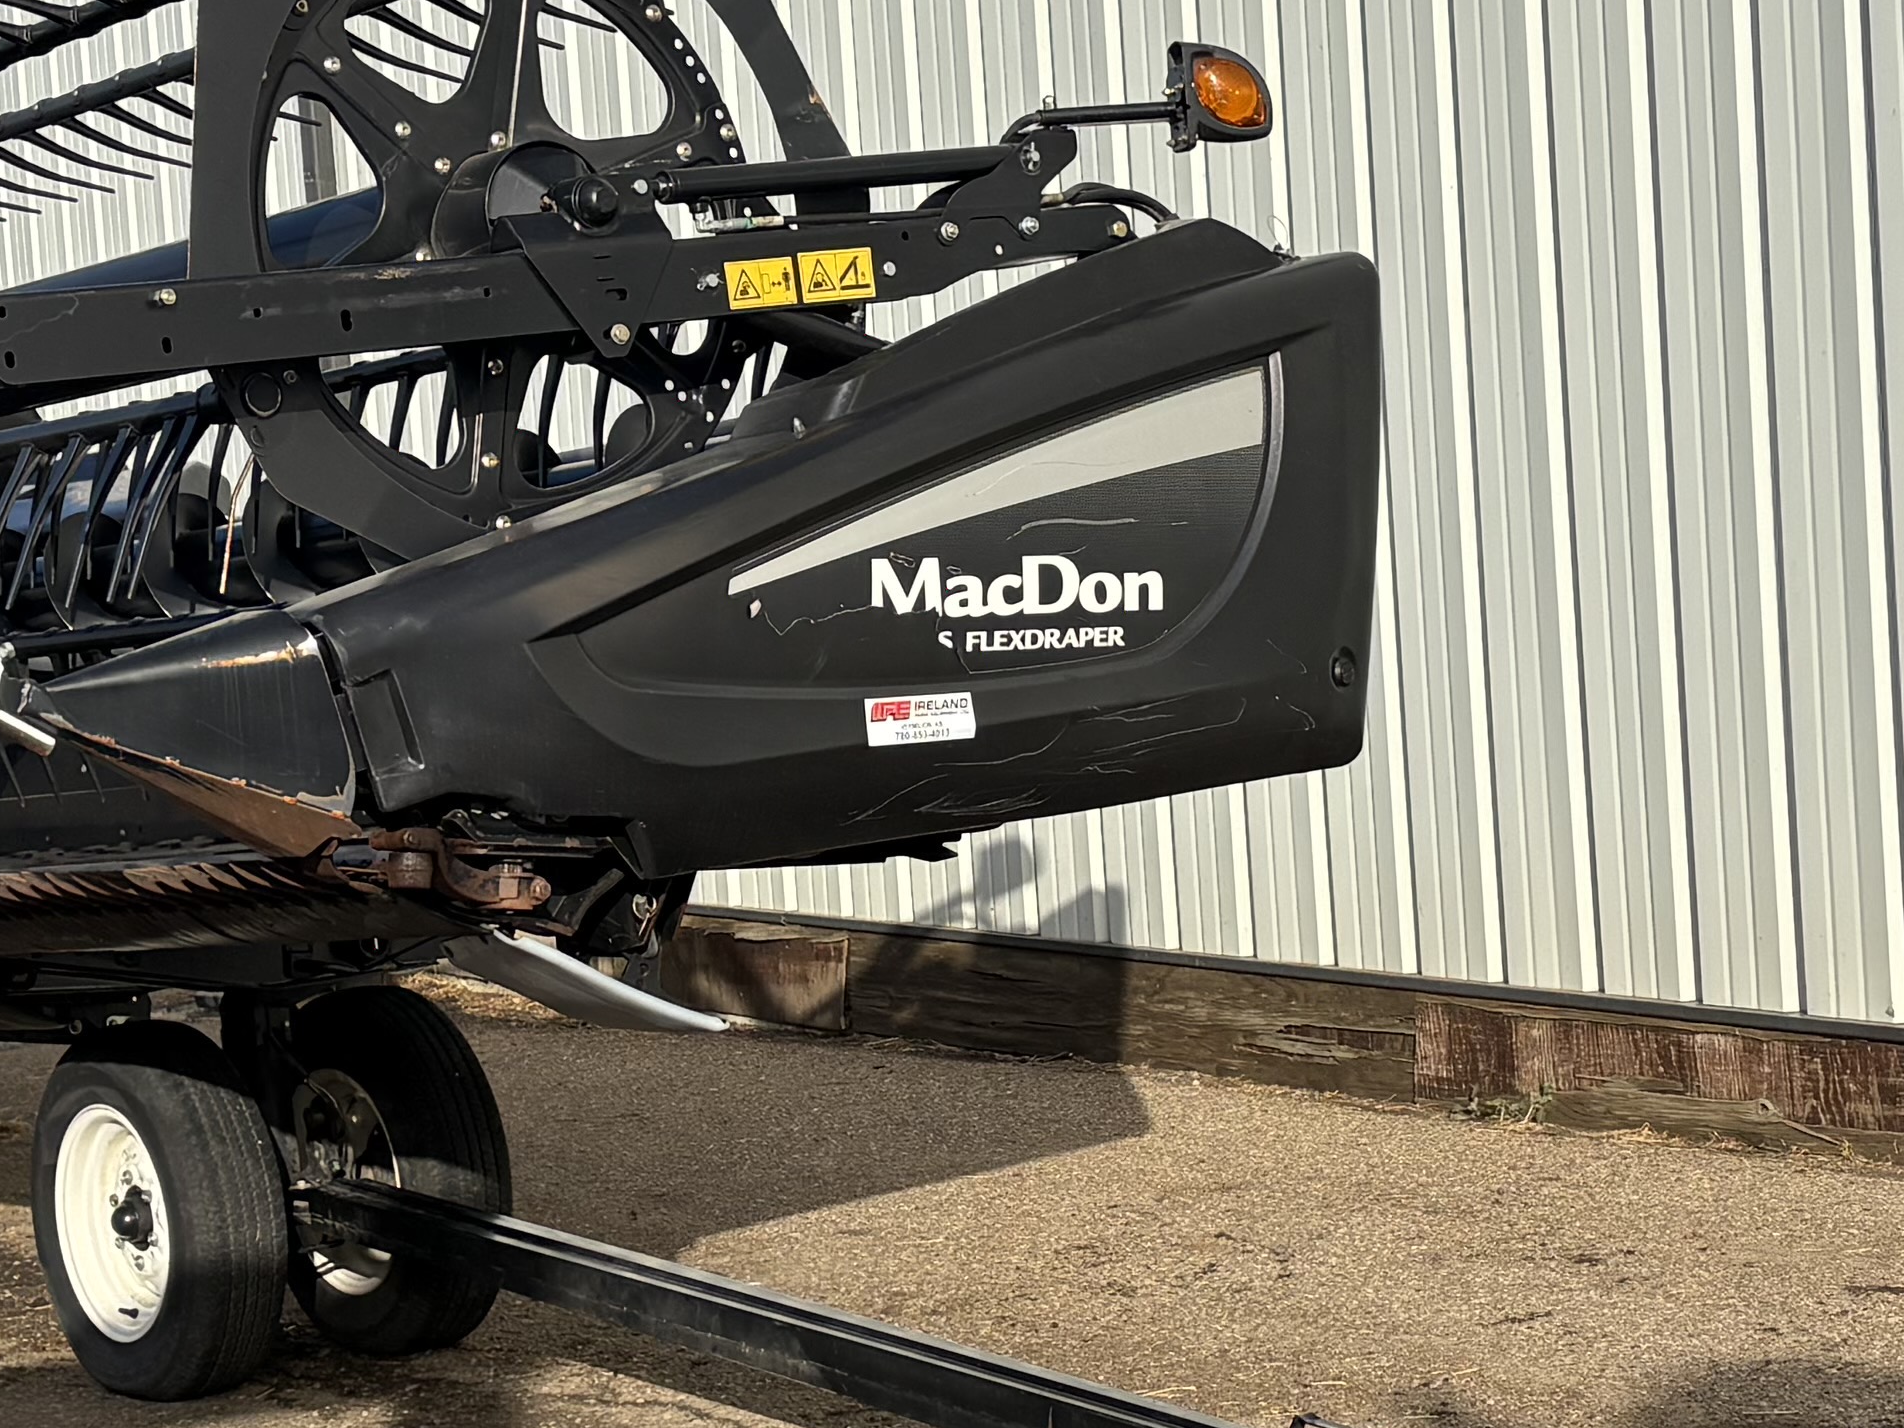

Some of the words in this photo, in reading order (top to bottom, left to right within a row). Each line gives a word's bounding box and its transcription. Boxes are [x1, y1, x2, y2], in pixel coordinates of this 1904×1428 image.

[871, 555, 1164, 618] MacDon
[965, 626, 1125, 652] FLEXDRAPER
[914, 698, 968, 711] IRELAND
